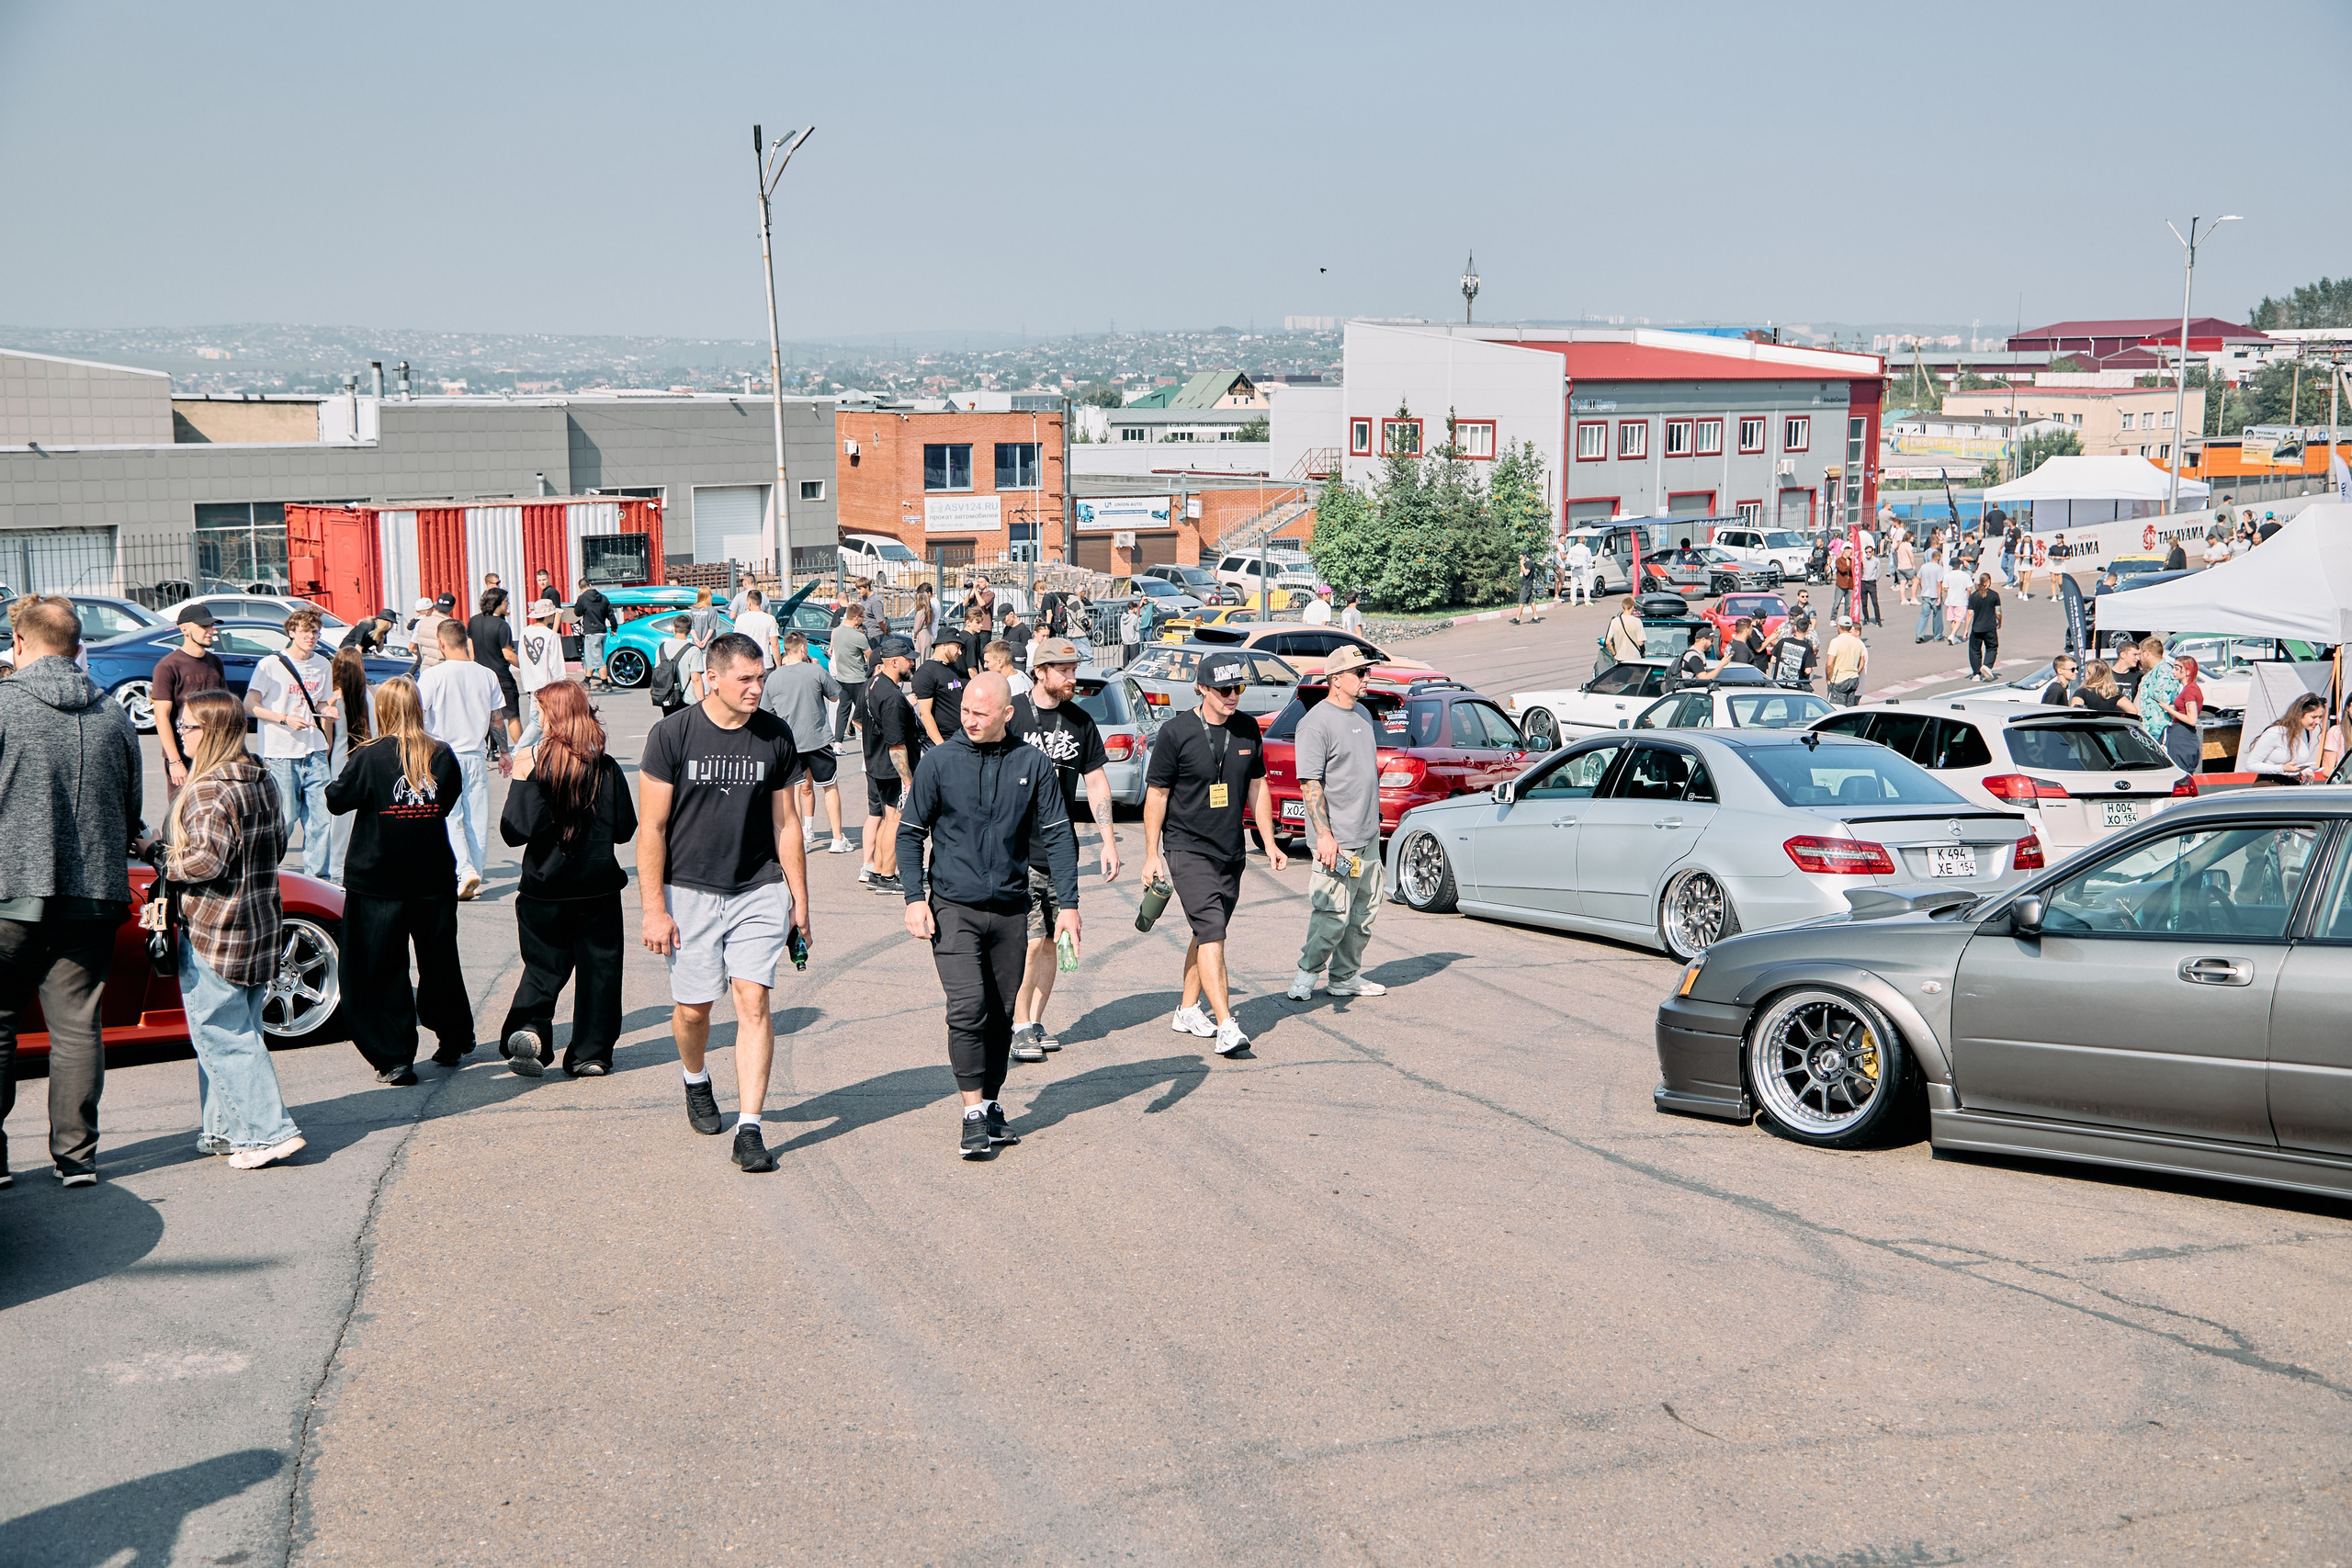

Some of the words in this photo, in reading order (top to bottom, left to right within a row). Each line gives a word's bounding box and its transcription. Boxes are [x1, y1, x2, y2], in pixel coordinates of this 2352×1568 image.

[1905, 438, 1939, 448] РЕМОНТ
[1942, 439, 2000, 451] ГРУЗОВИКОВ
[1888, 469, 1911, 478] АРЕНДА
[944, 502, 999, 512] ASV124.RU
[2158, 525, 2204, 545] TAKAYAMA
[2069, 541, 2099, 558] AYAMA
[288, 681, 320, 695] EXPNSIVE
[2116, 803, 2132, 813] 004
[1948, 848, 1966, 860] 494
[1960, 862, 1974, 871] 154
